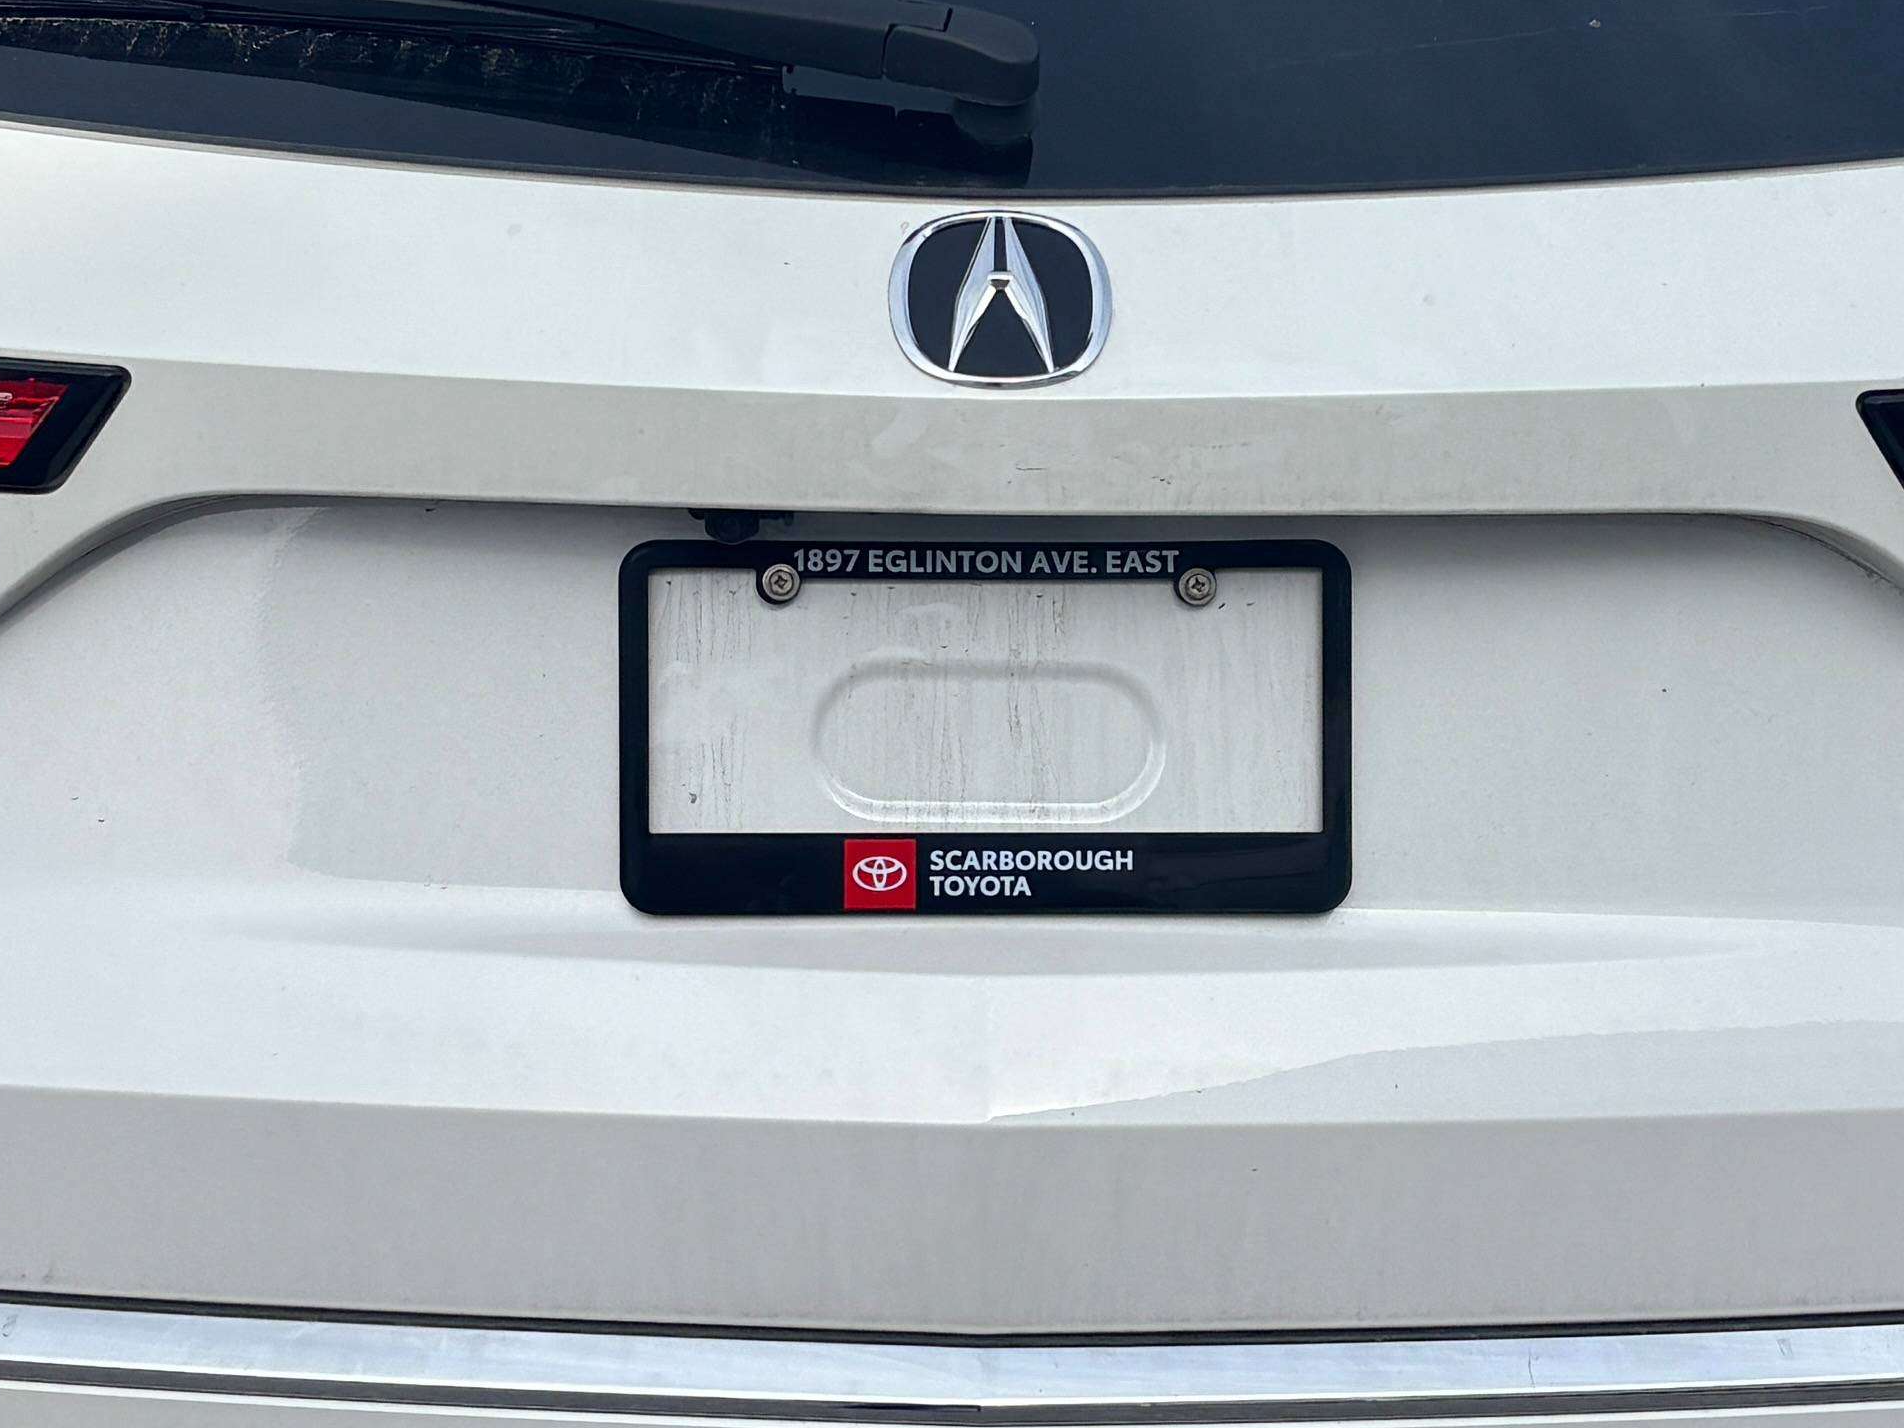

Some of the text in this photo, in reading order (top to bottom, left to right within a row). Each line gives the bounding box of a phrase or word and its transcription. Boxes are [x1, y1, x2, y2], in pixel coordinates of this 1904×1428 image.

[793, 548, 1180, 574] 1897 EGLINTON AVE. EAST
[929, 849, 1134, 871] SCARBOROUGH
[929, 875, 1032, 897] TOYOTA
